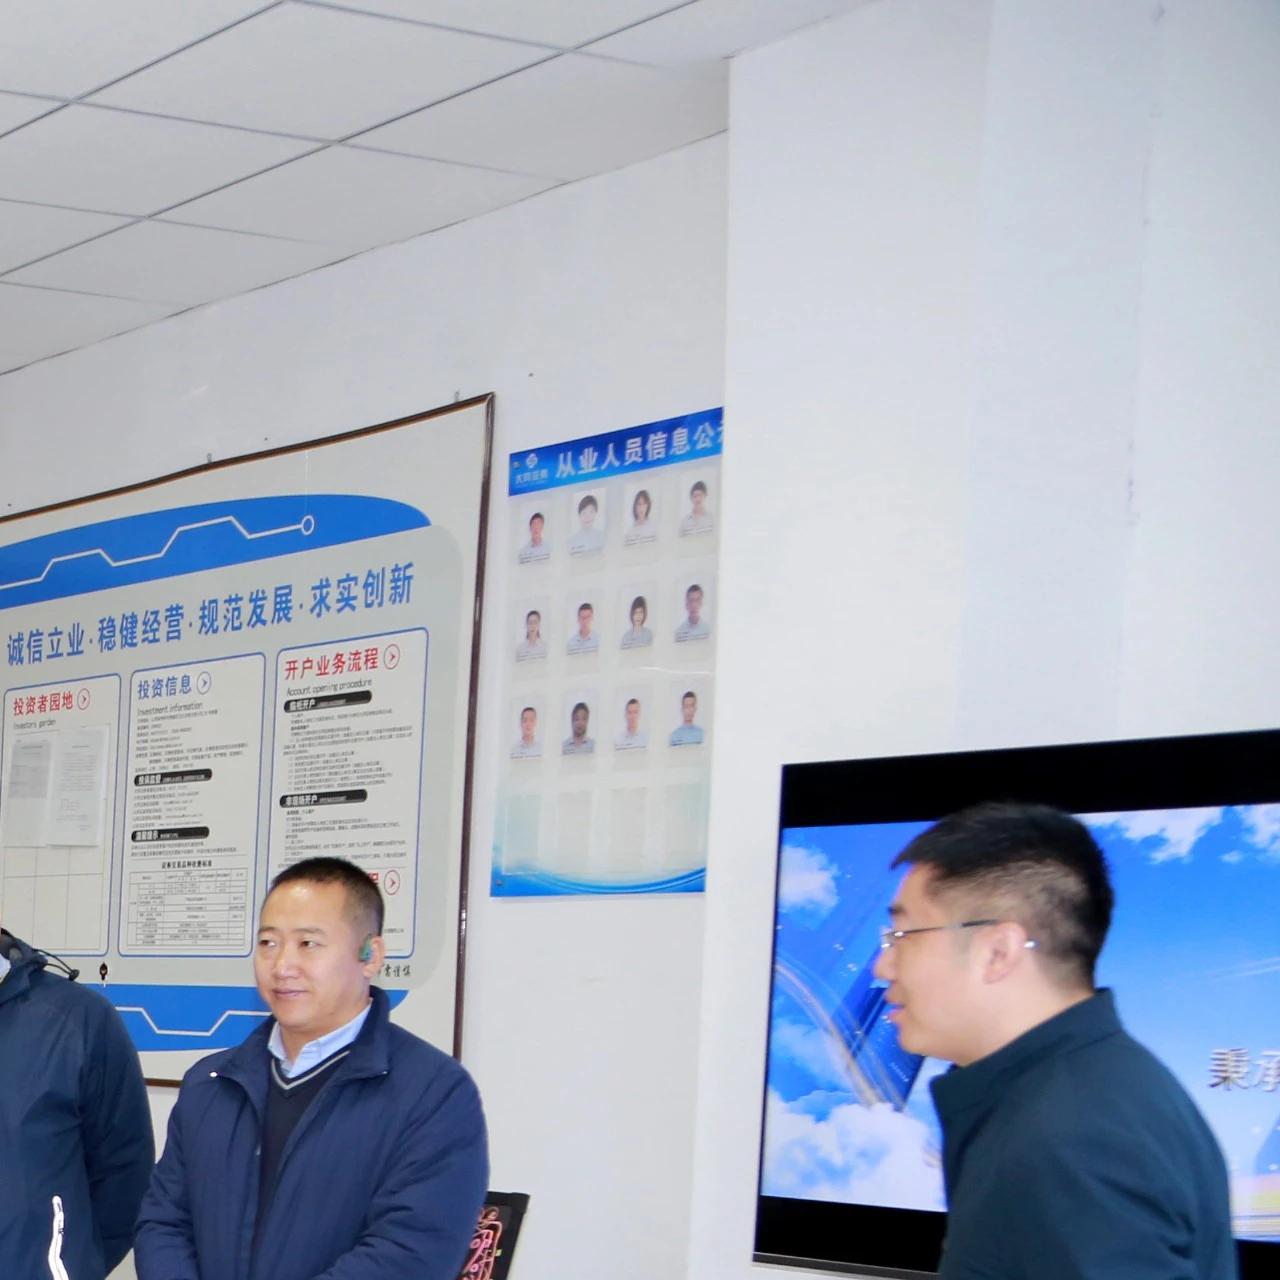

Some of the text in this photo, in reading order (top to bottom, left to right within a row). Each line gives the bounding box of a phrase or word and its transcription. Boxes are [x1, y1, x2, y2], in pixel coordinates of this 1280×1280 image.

[284, 647, 379, 681] 开户业务流程
[137, 673, 192, 700] 投资信息
[13, 690, 73, 716] 投资者园地
